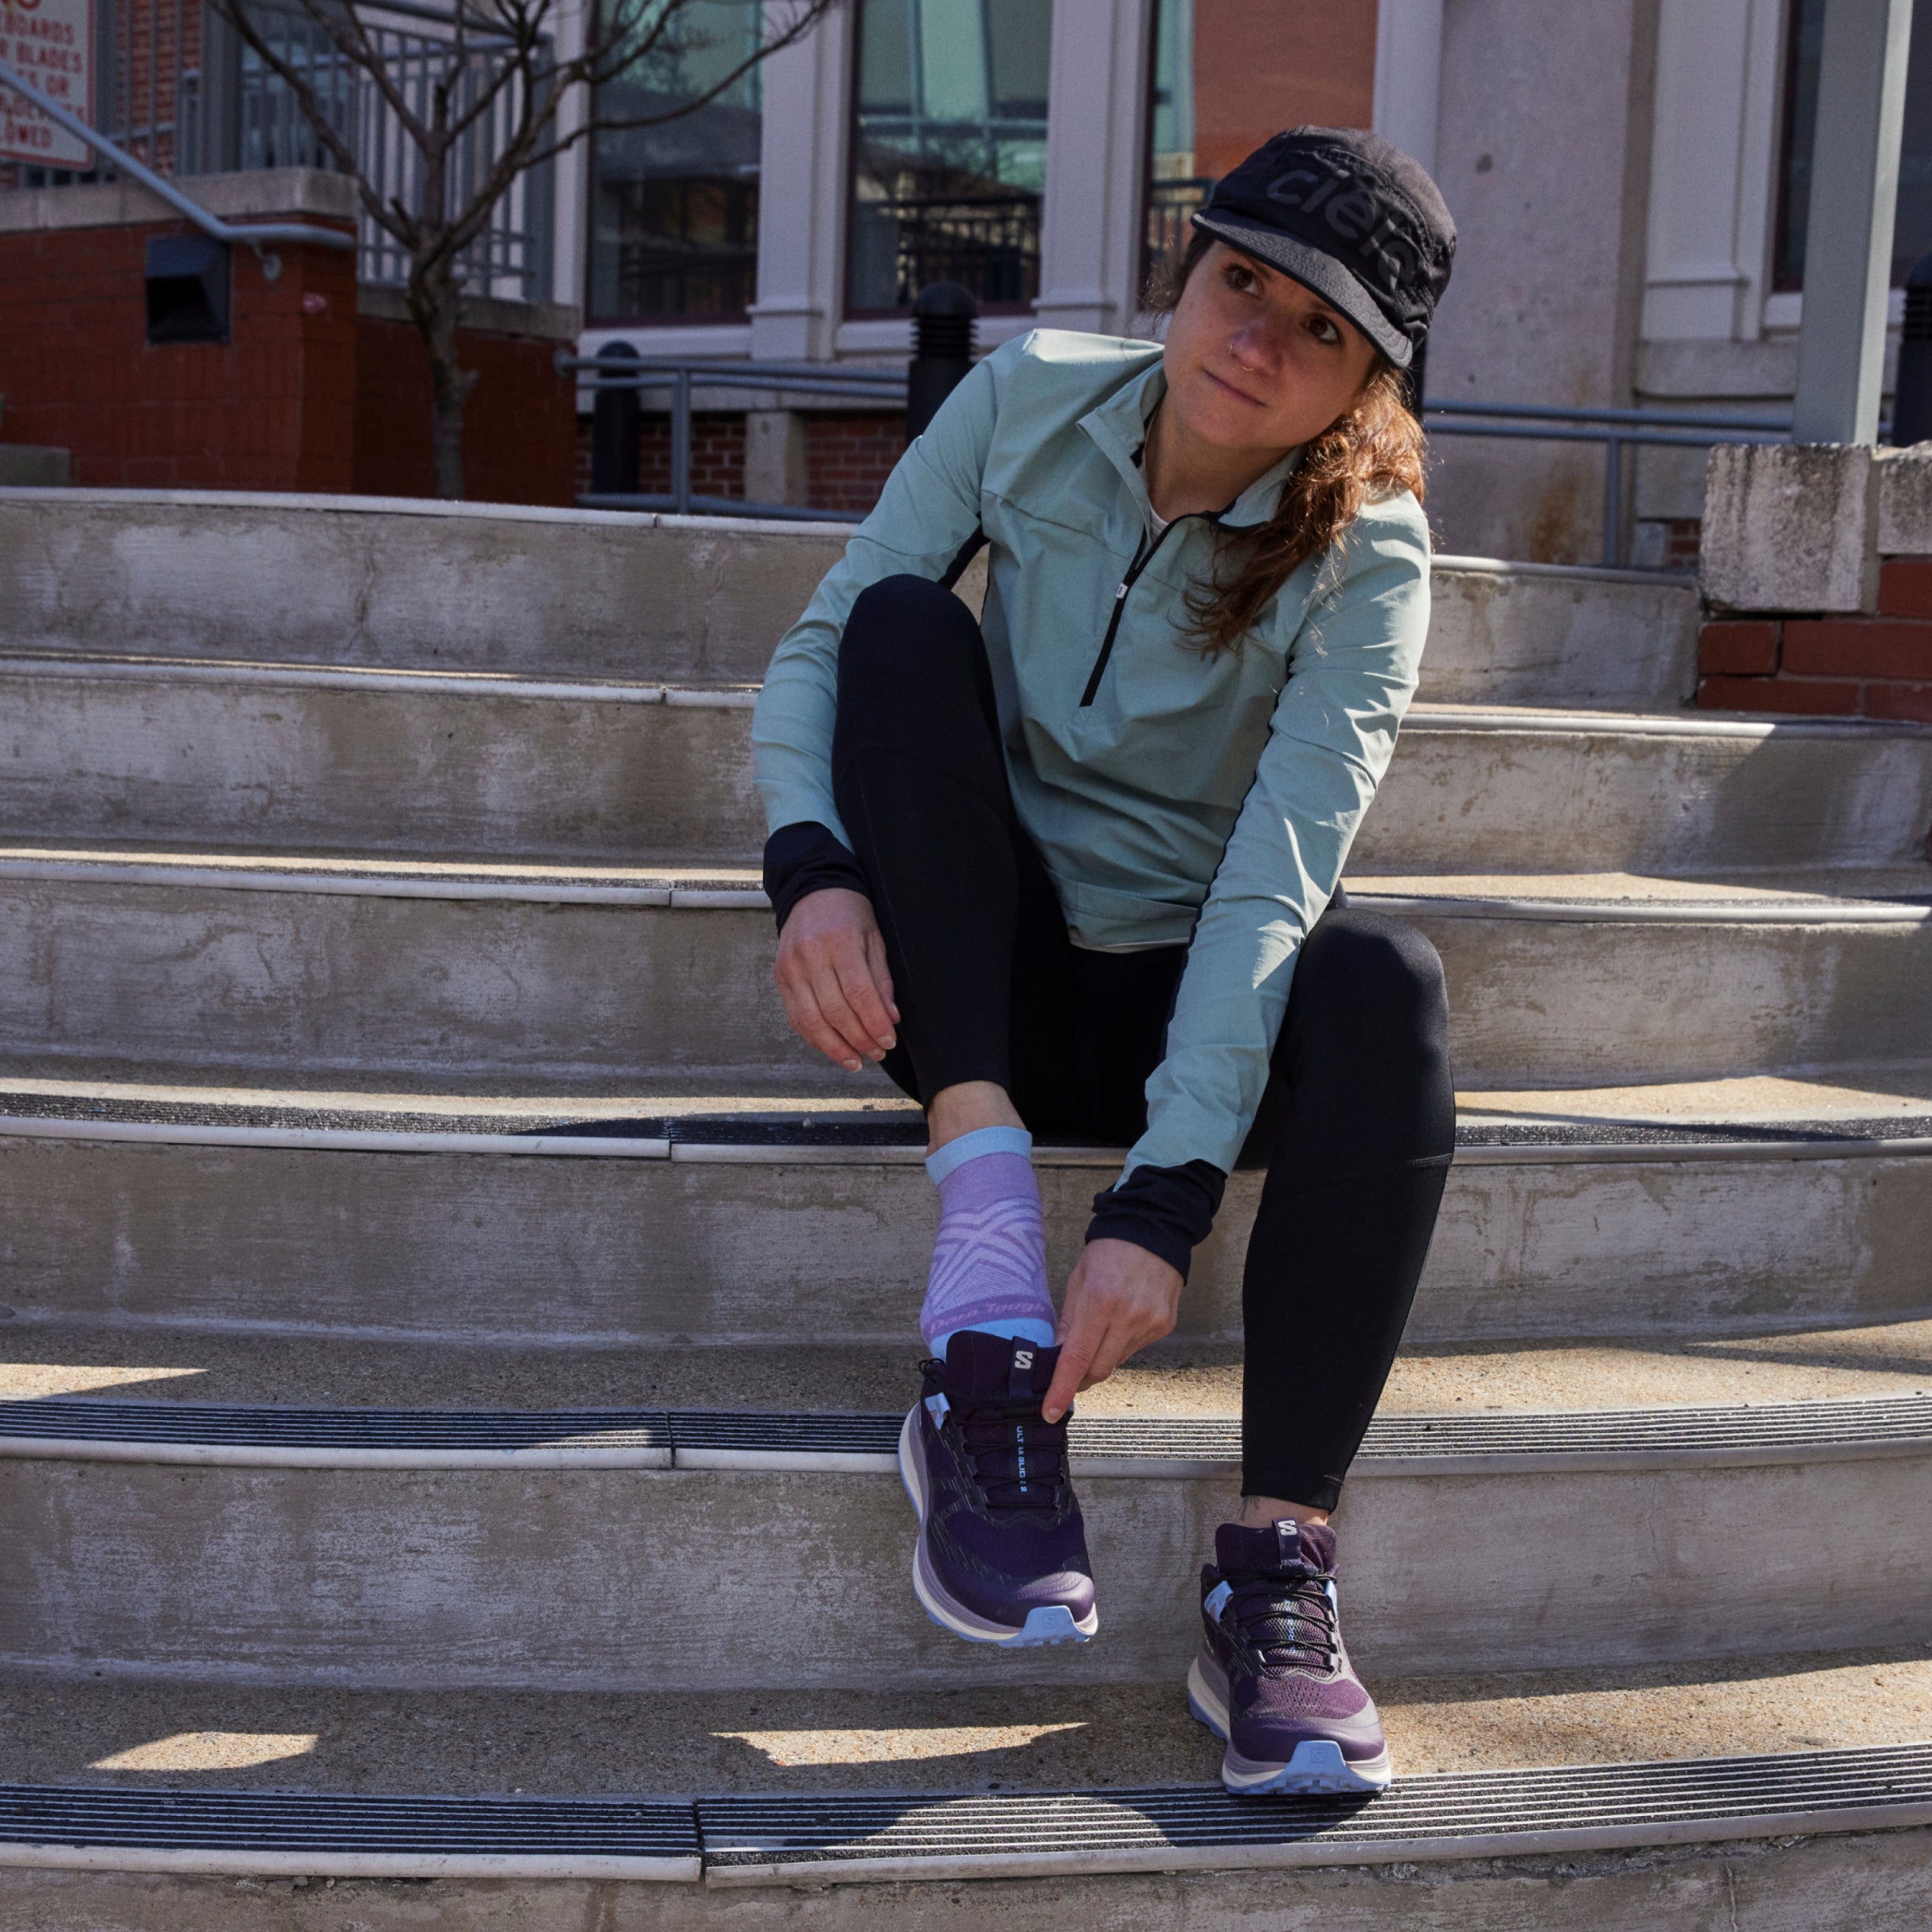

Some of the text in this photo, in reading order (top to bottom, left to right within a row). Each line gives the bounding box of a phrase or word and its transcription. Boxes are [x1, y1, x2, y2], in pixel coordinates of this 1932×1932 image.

[16, 41, 82, 74] BLADES
[0, 120, 53, 149] OWED
[1266, 169, 1415, 290] ciele
[1014, 1351, 1034, 1369] S
[1278, 1520, 1297, 1536] S
